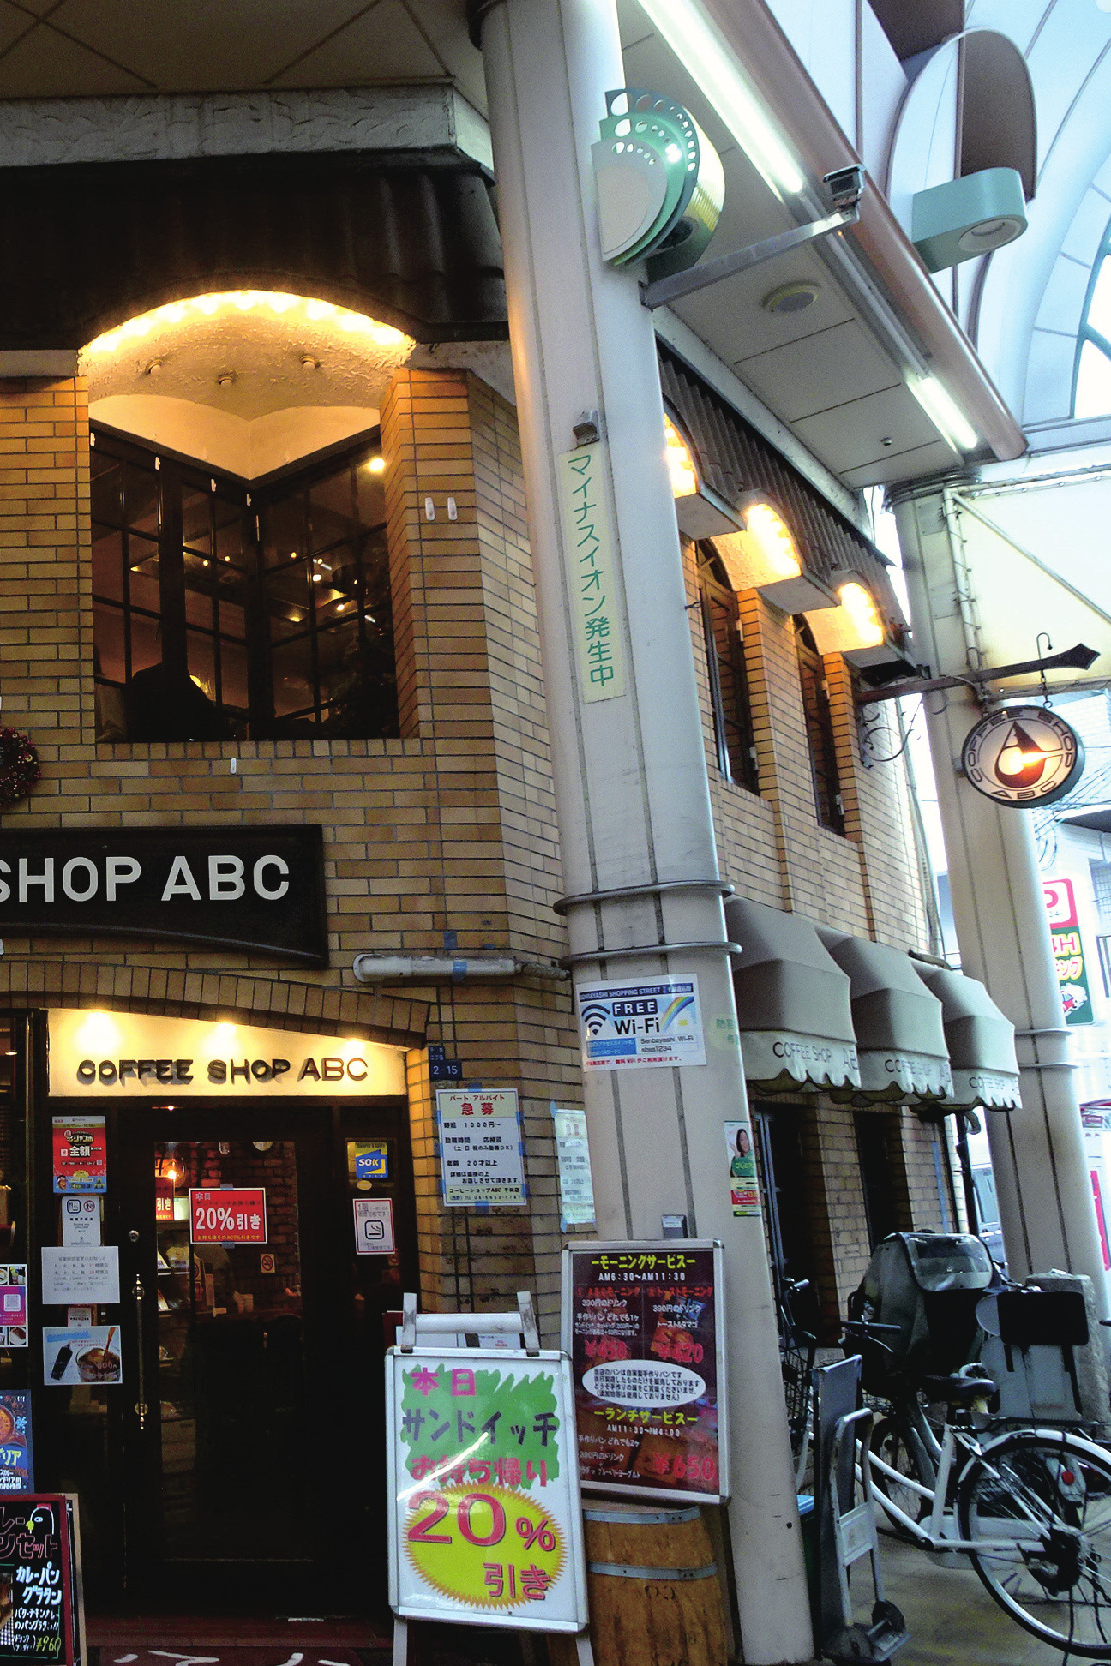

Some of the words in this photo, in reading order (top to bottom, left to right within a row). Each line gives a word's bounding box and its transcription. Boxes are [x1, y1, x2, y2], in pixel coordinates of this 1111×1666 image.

[568, 455, 614, 687] マイナスイオン発生中
[160, 854, 290, 902] ABC
[613, 1001, 657, 1015] FREE
[614, 1017, 660, 1035] Wi-Fi
[79, 1058, 194, 1082] COFFEE
[207, 1057, 291, 1081] SHOP
[299, 1057, 369, 1083] ABC
[410, 1367, 477, 1397] 本日
[402, 1408, 557, 1447] サンドイッチ
[409, 1454, 547, 1488] お持ち帰り
[406, 1489, 557, 1552] 20%
[21, 1584, 63, 1606] グラタン
[482, 1562, 552, 1601] 引き
